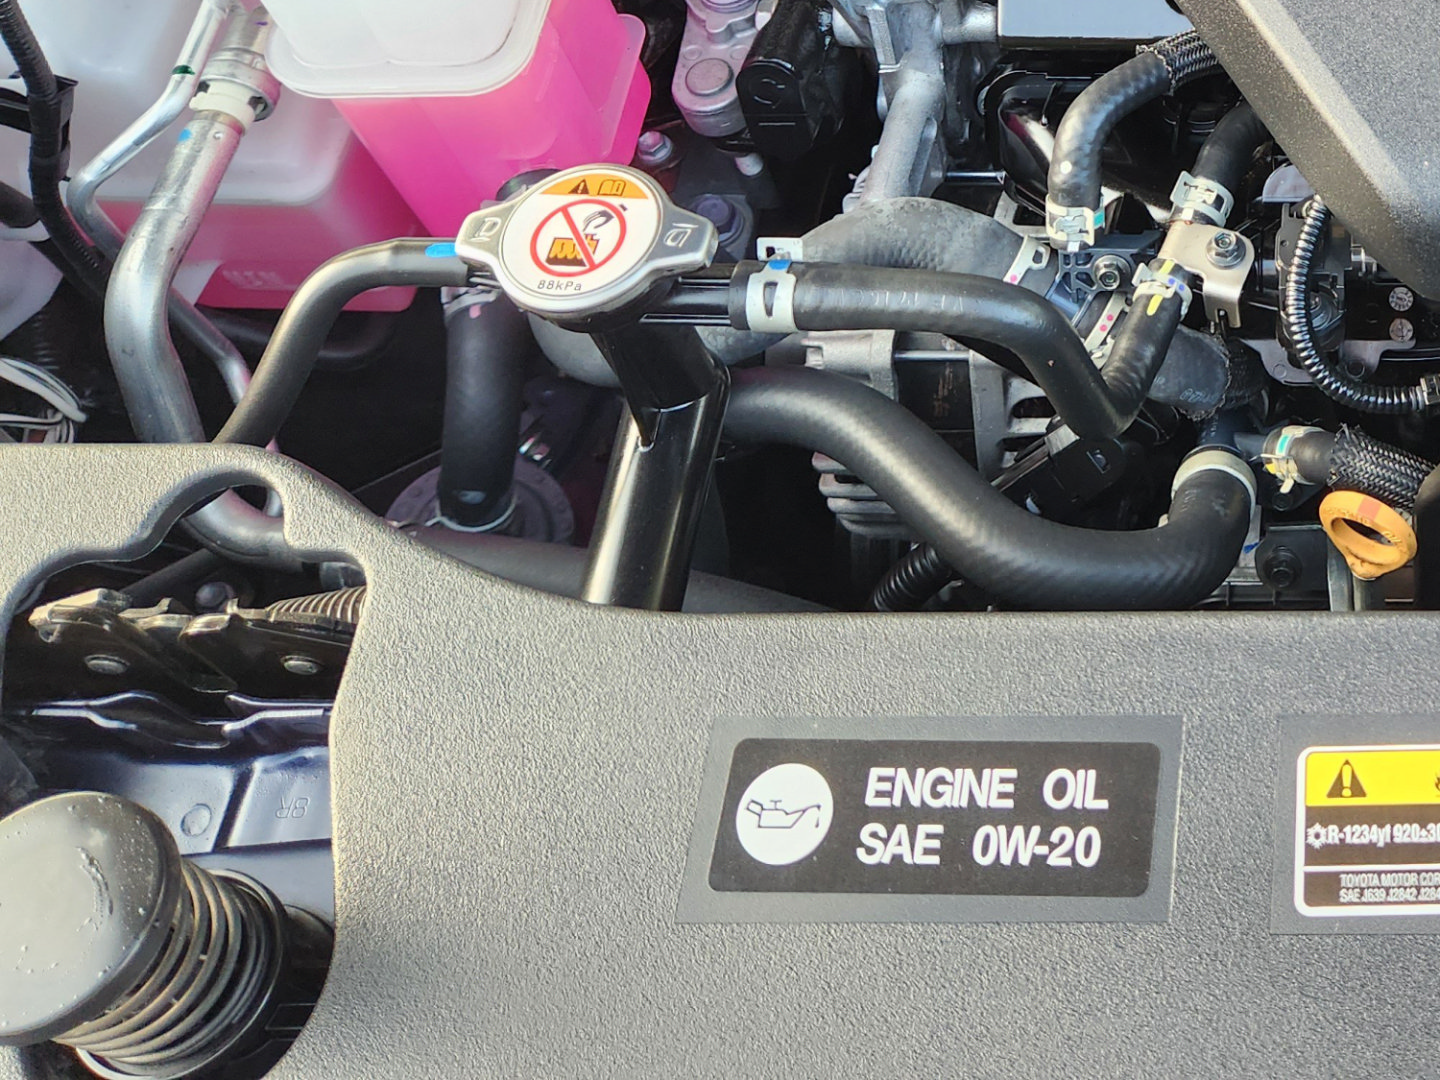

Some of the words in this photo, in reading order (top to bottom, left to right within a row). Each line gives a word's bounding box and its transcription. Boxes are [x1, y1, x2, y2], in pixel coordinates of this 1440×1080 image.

[537, 280, 583, 292] 88kPa
[864, 767, 1018, 808] ENGINE
[1042, 768, 1109, 810] OIL
[856, 822, 944, 865] SAE
[972, 825, 1102, 868] 0W-20
[1327, 823, 1392, 848] R-1234yf
[1339, 872, 1380, 888] TOYOTA
[1380, 871, 1419, 887] MOTOR
[1339, 887, 1361, 903] SAE
[1361, 887, 1387, 902] J639
[1387, 886, 1418, 901] J2842
